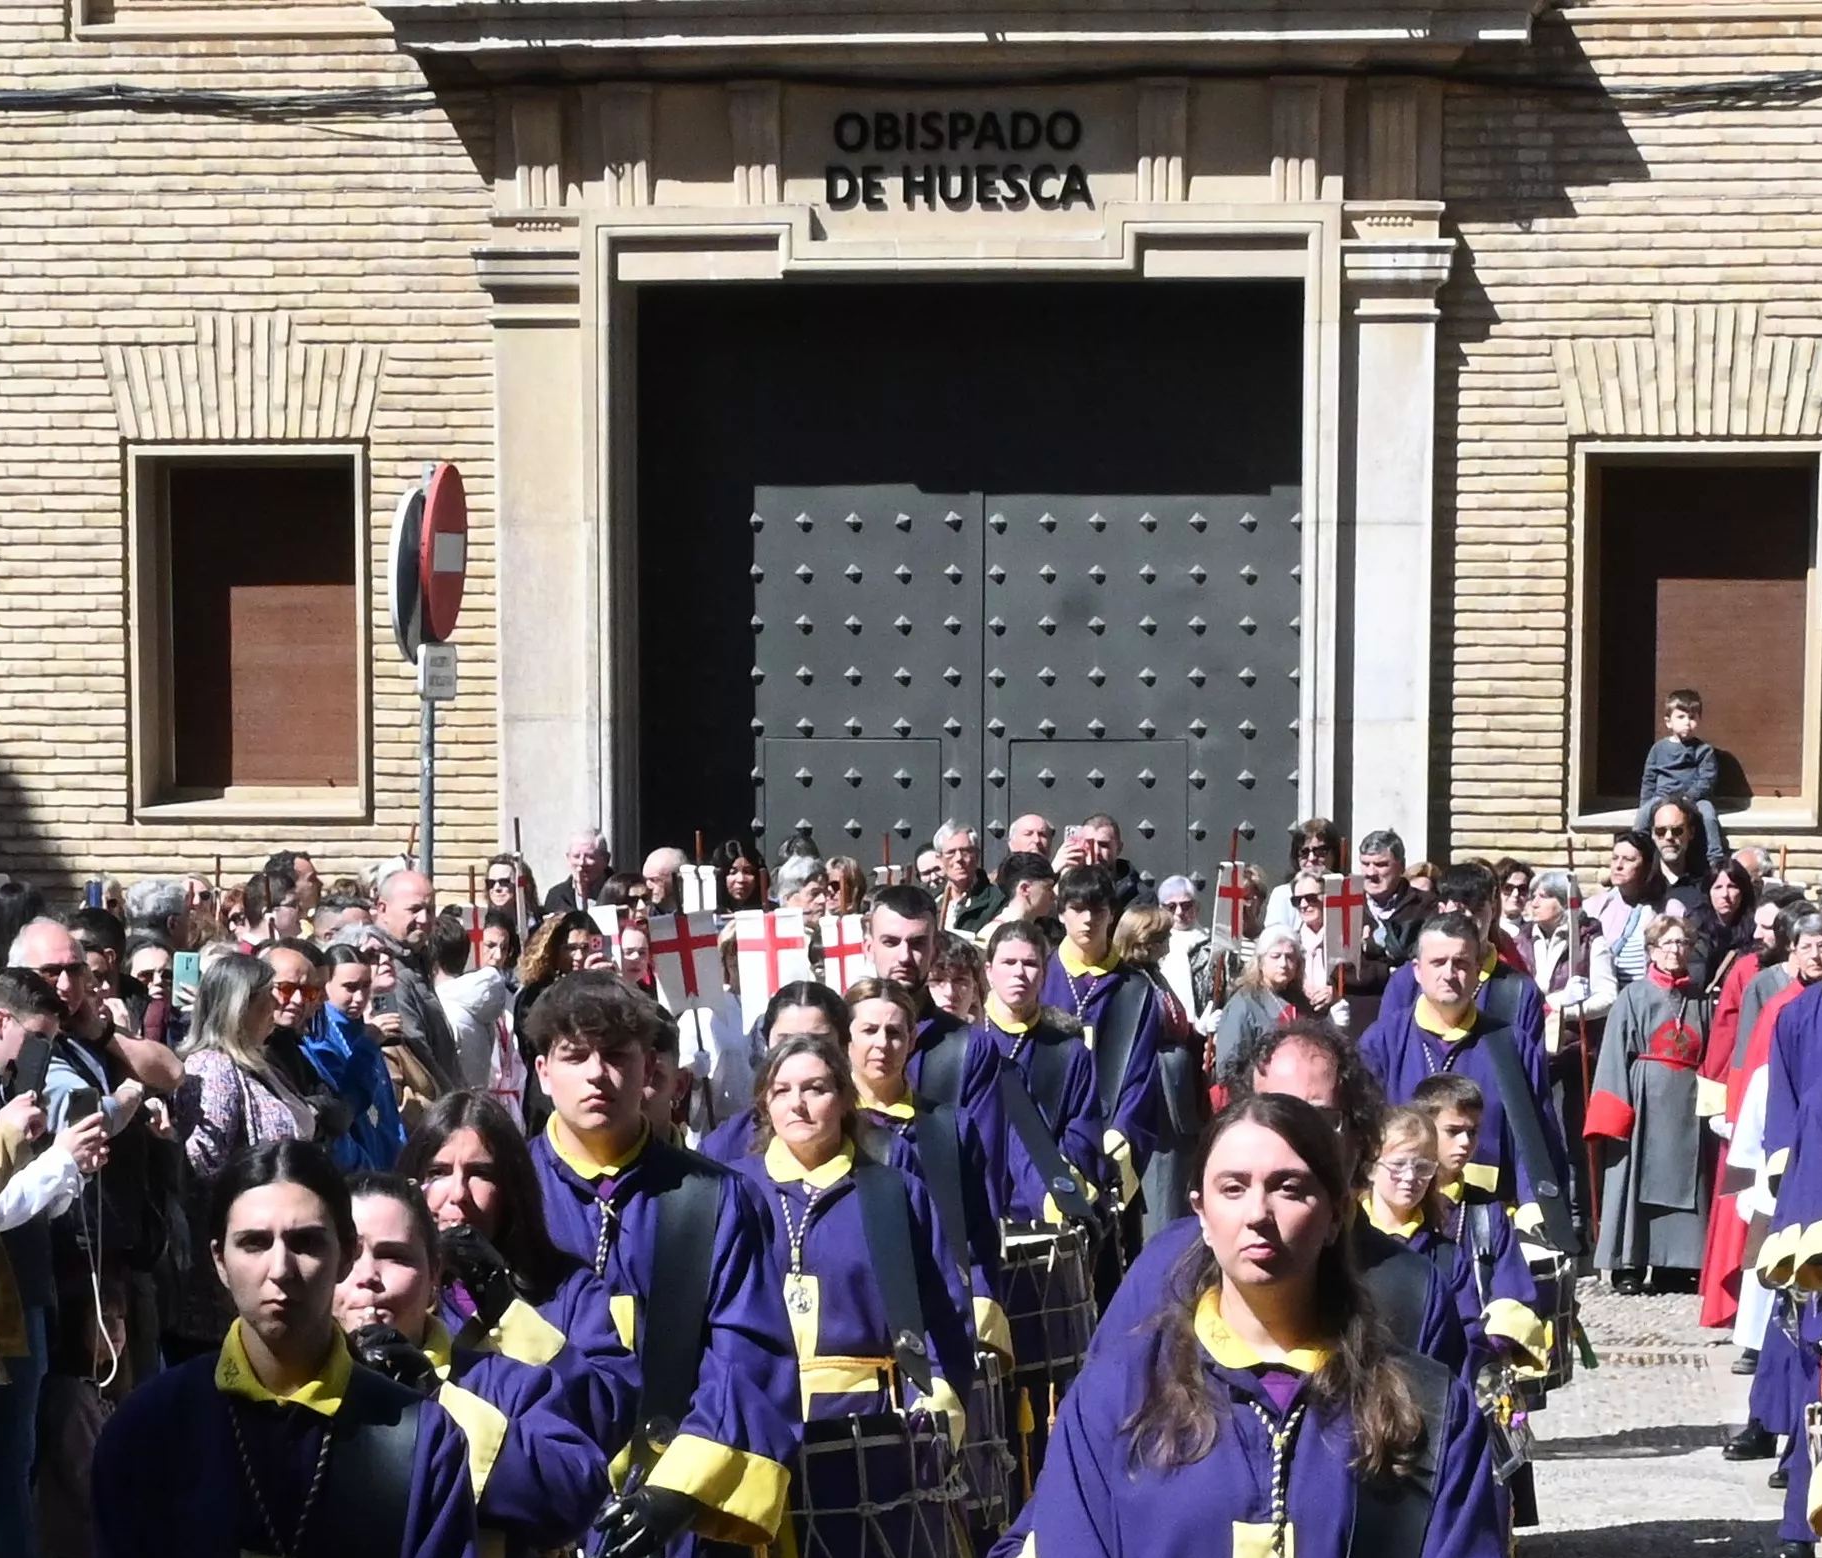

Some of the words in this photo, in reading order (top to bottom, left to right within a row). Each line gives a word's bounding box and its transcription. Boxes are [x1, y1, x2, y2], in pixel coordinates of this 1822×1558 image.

[833, 111, 1083, 153] OBISPADO
[825, 164, 885, 209] DE
[902, 164, 1094, 210] HUESCA
